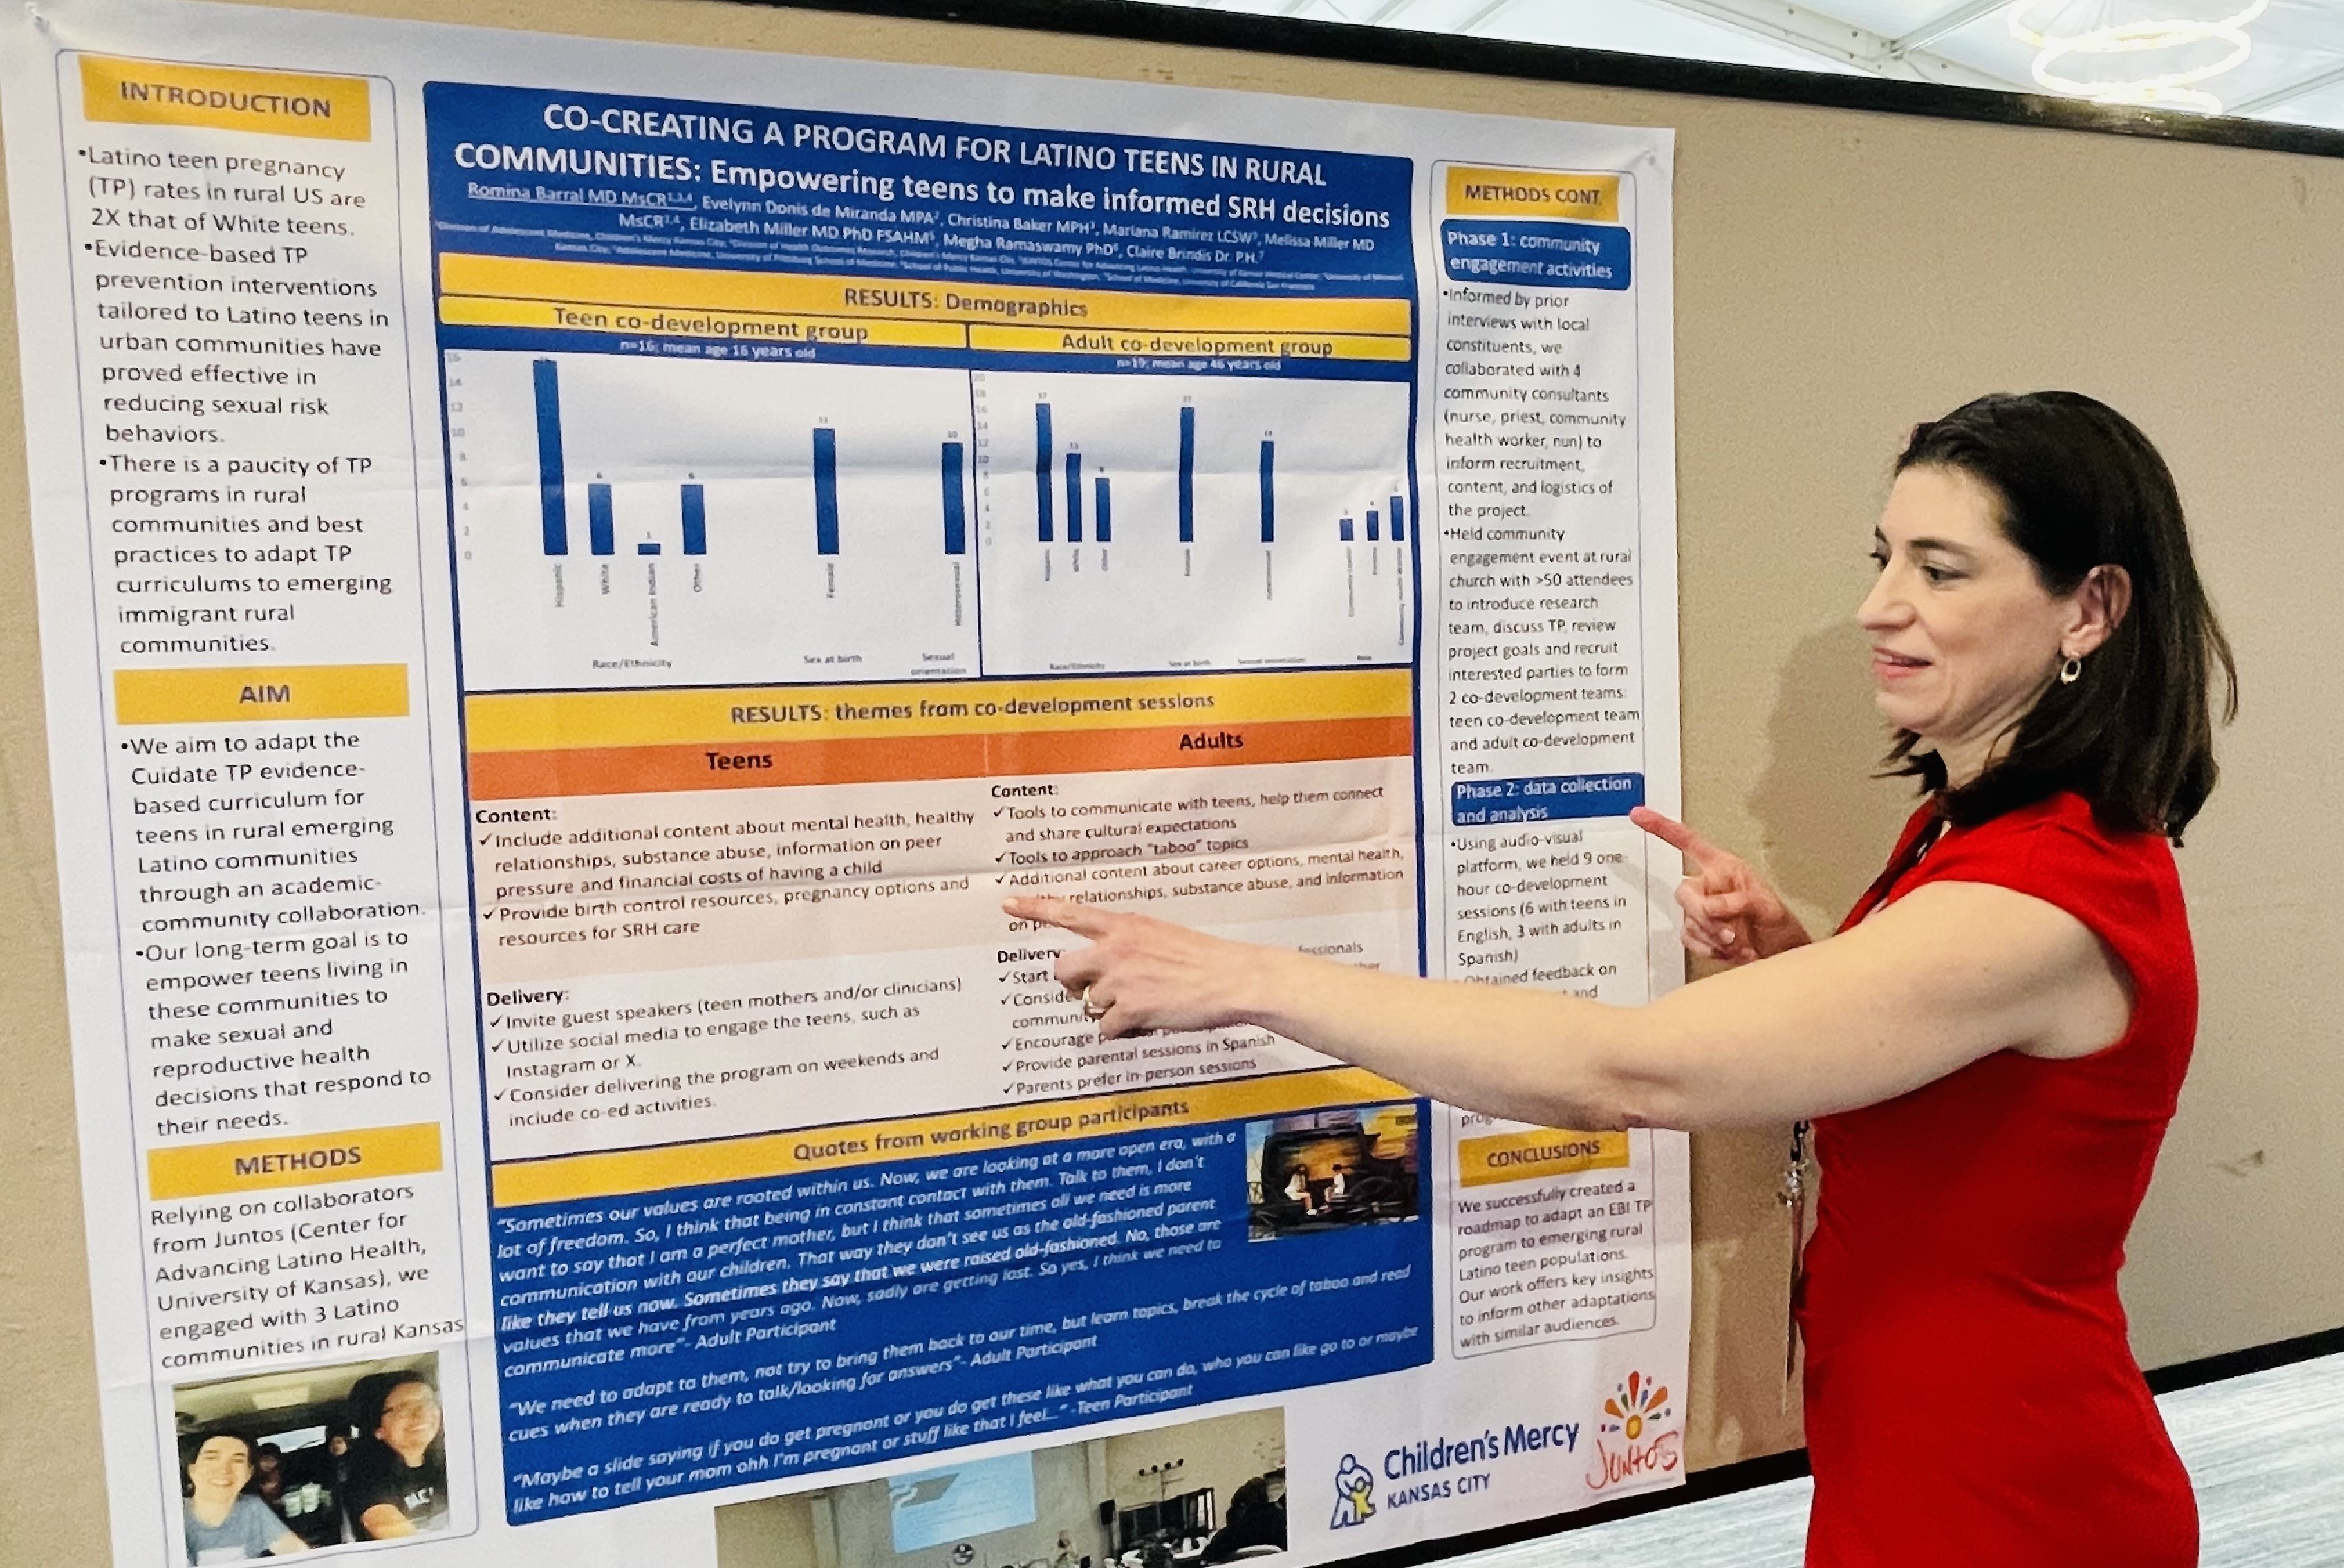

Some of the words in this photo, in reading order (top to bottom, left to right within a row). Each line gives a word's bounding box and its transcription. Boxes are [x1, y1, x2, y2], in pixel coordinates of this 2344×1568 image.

[121, 81, 331, 118] INTRODUCTION
[543, 104, 754, 144] CO-CREATING
[763, 122, 785, 147] A
[794, 123, 946, 158] PROGRAM
[956, 136, 1011, 164] FOR
[1021, 141, 1116, 170] LATINO
[1123, 148, 1204, 176] TEENS
[1211, 155, 1238, 180] IN
[1245, 158, 1326, 187] RURAL
[89, 145, 160, 167] Latino
[167, 152, 218, 169] teen
[225, 156, 346, 183] pregnancy
[89, 176, 136, 200] (TP)
[144, 183, 201, 200] rates
[207, 183, 227, 200] in
[234, 185, 285, 203] rural
[293, 187, 324, 205] US
[331, 194, 366, 209] are
[454, 142, 701, 183] COMMUNITIES:
[711, 159, 895, 202] Empowering
[902, 174, 979, 202] teens
[986, 181, 1015, 205] to
[1023, 183, 1095, 210] make
[1104, 187, 1220, 217] informed
[1228, 195, 1275, 221] SRH
[1283, 199, 1390, 228] decisions
[1465, 184, 1550, 203] METHODS
[689, 217, 759, 235] Elizabeth
[763, 221, 808, 238] Miller
[812, 224, 839, 239] MD
[842, 226, 873, 242] PhD
[947, 213, 1010, 230] Christina
[1013, 217, 1052, 232] Baker
[943, 232, 992, 251] Megha
[996, 237, 1082, 258] Ramaswamy
[1126, 245, 1164, 260] Claire
[1167, 247, 1212, 262] Brindis
[1447, 231, 1496, 247] Phase
[1500, 232, 1516, 248] 1:
[1520, 235, 1601, 256] community
[1449, 257, 1545, 275] engagement
[1546, 262, 1612, 279] activities
[845, 288, 938, 309] RESULTS:
[946, 293, 1088, 318] Demographics
[553, 308, 607, 328] Teen
[615, 312, 799, 338] co-development
[806, 325, 868, 344] group
[662, 343, 701, 354] mean
[705, 346, 729, 358] age
[732, 344, 749, 357] 16
[751, 346, 792, 360] years
[794, 347, 816, 360] old
[1062, 335, 1115, 352] Adult
[1120, 337, 1274, 358] co-development
[1281, 341, 1334, 359] group
[1152, 360, 1185, 369] mean
[1187, 360, 1207, 372] age
[1210, 358, 1225, 370] 46
[1227, 360, 1263, 372] years
[1263, 360, 1282, 371] old
[1451, 526, 1483, 541] Held
[1487, 528, 1565, 543] community
[693, 563, 702, 592] Other
[592, 658, 673, 669] Race/Ethnicity
[803, 655, 821, 664] Sex
[824, 655, 835, 664] at
[837, 654, 863, 664] birth
[922, 652, 954, 662] Sexual
[910, 667, 967, 676] orientation
[239, 684, 290, 704] AIM
[731, 704, 828, 725] RESULTS:
[835, 702, 913, 721] themes
[920, 700, 969, 718] from
[974, 696, 1133, 716] co-development
[1137, 693, 1216, 711] sessions
[127, 738, 167, 755] We
[176, 736, 216, 754] aim
[224, 737, 248, 752] to
[254, 733, 317, 752] adapt
[324, 731, 360, 748] the
[1179, 731, 1243, 751] Adults
[705, 752, 773, 770] Teens
[992, 784, 1058, 798] Content:
[1456, 783, 1503, 799] Phase
[1506, 781, 1519, 797] 2:
[1523, 780, 1557, 796] data
[1560, 776, 1632, 794] collection
[476, 809, 555, 824] Content:
[1456, 808, 1486, 824] and
[1489, 805, 1549, 823] analysis
[496, 832, 563, 848] Include
[568, 825, 658, 844] additional
[664, 823, 730, 839] content
[736, 820, 785, 835] about
[791, 814, 849, 832] mental
[855, 812, 910, 828] health,
[915, 810, 975, 825] healthy
[1010, 851, 1049, 866] Tools
[1052, 852, 1068, 863] to
[1072, 843, 1142, 866] approach
[1206, 839, 1249, 854] topics
[1458, 949, 1518, 968] Spanish)
[487, 989, 570, 1007] Delivery:
[506, 1061, 596, 1079] Instagram
[602, 1058, 620, 1070] or
[1017, 1079, 1073, 1095] Parents
[1077, 1072, 1122, 1091] prefer
[1126, 1066, 1195, 1083] in-person
[1199, 1059, 1257, 1075] sessions
[794, 1139, 868, 1161] Quotes
[874, 1132, 924, 1151] from
[930, 1122, 1012, 1145] working
[1016, 1116, 1073, 1138] group
[1079, 1101, 1189, 1131] participants
[235, 1146, 362, 1175] METHODS
[1487, 1139, 1600, 1168] CONCLUSIONS
[1459, 1264, 1502, 1282] Latino
[1505, 1258, 1536, 1273] teen
[1540, 1249, 1628, 1271] populations.
[159, 1312, 253, 1341] engaged
[260, 1308, 307, 1327] with
[315, 1306, 326, 1323] 3
[333, 1298, 399, 1320] Latino
[1460, 1332, 1491, 1348] with
[1494, 1323, 1541, 1343] similar
[1543, 1316, 1619, 1334] audiences.
[162, 1341, 304, 1369] communities
[311, 1337, 330, 1351] in
[337, 1325, 386, 1347] rural
[394, 1316, 465, 1341] Kansas
[503, 1348, 625, 1378] communicate
[694, 1329, 743, 1350] Adult
[745, 1318, 837, 1342] Participant
[1383, 1430, 1500, 1481] Children's
[1503, 1423, 1579, 1456] Mercy
[1387, 1480, 1451, 1509] KANSAS
[1457, 1473, 1491, 1495] CITY
